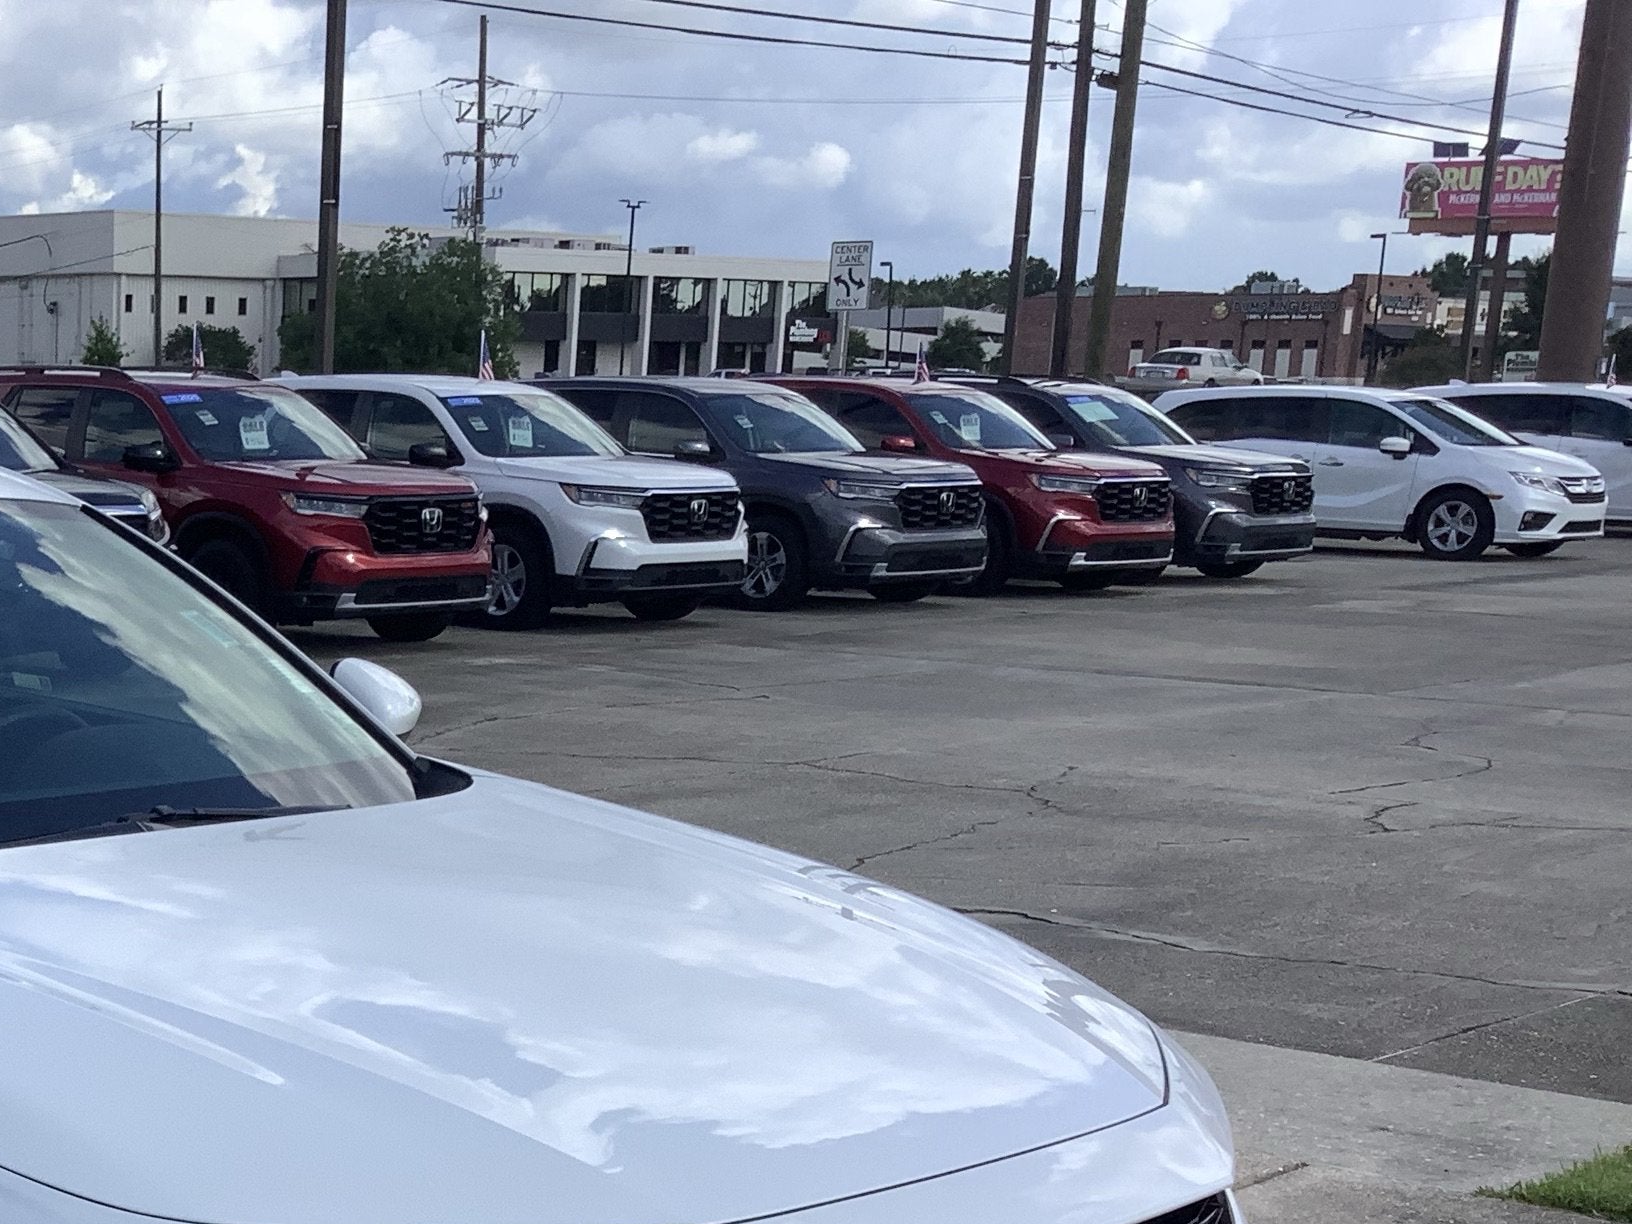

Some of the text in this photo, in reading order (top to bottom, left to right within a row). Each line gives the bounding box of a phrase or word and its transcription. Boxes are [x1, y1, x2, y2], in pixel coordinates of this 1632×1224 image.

[834, 245, 869, 255] CENTER
[839, 255, 863, 264] LANE
[835, 298, 860, 307] ONLY
